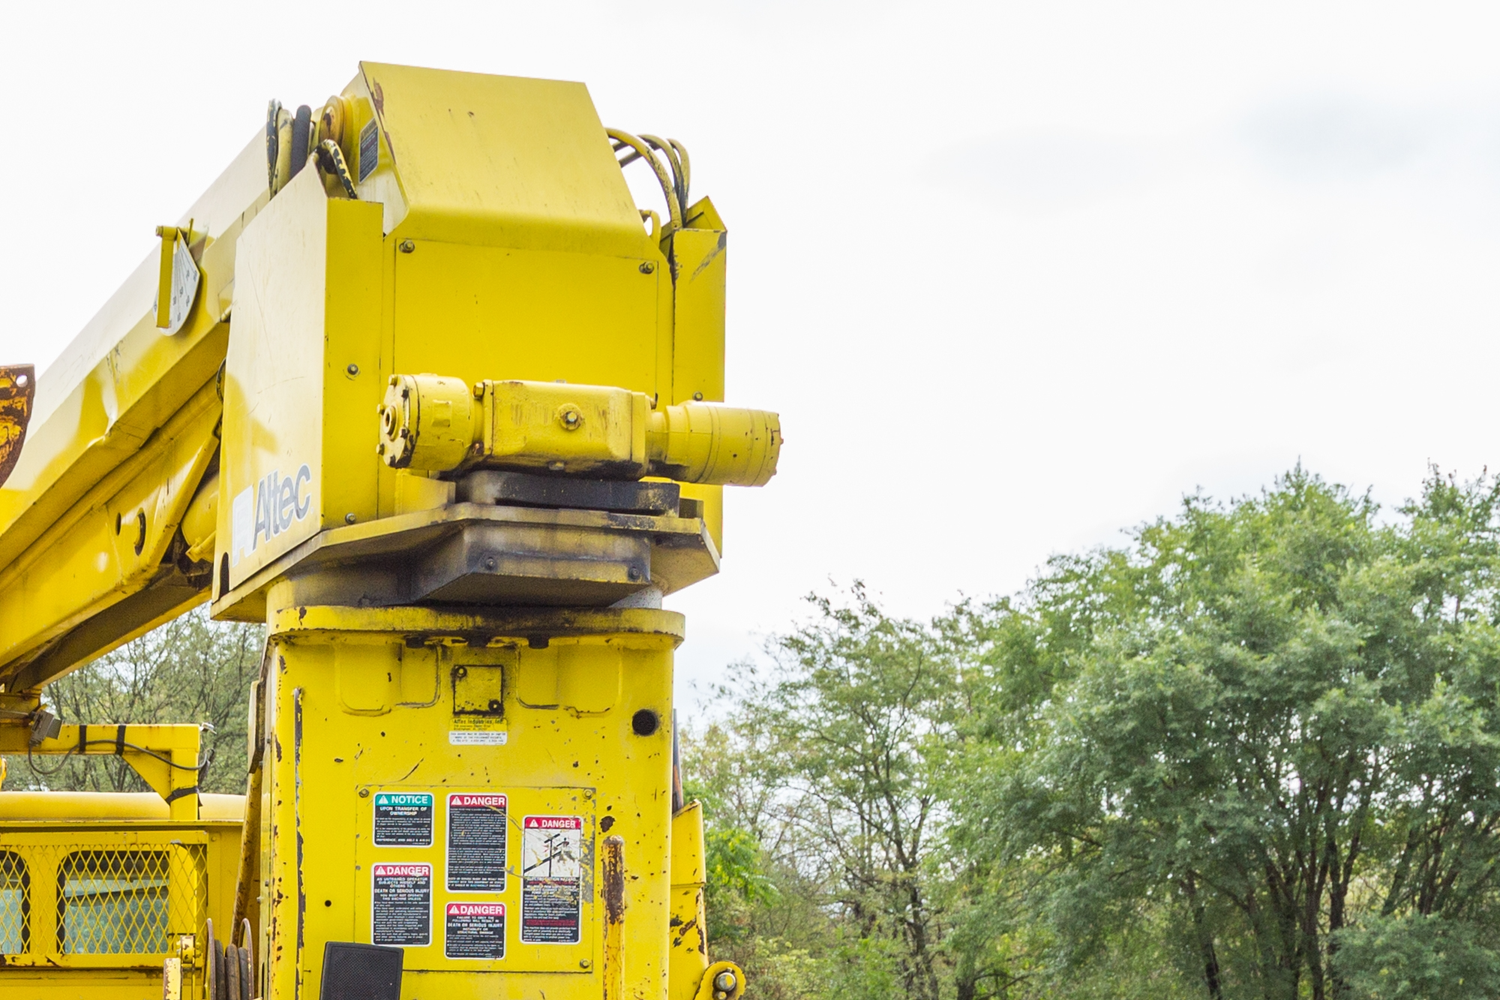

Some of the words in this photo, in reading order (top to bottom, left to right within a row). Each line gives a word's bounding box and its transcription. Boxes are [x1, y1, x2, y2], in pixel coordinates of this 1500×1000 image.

[252, 463, 311, 551] Altec
[391, 795, 428, 804] NOTICE
[463, 796, 505, 806] DANGER
[541, 819, 577, 828] DANGER
[386, 866, 429, 875] DANGER
[460, 905, 503, 915] DANGER
